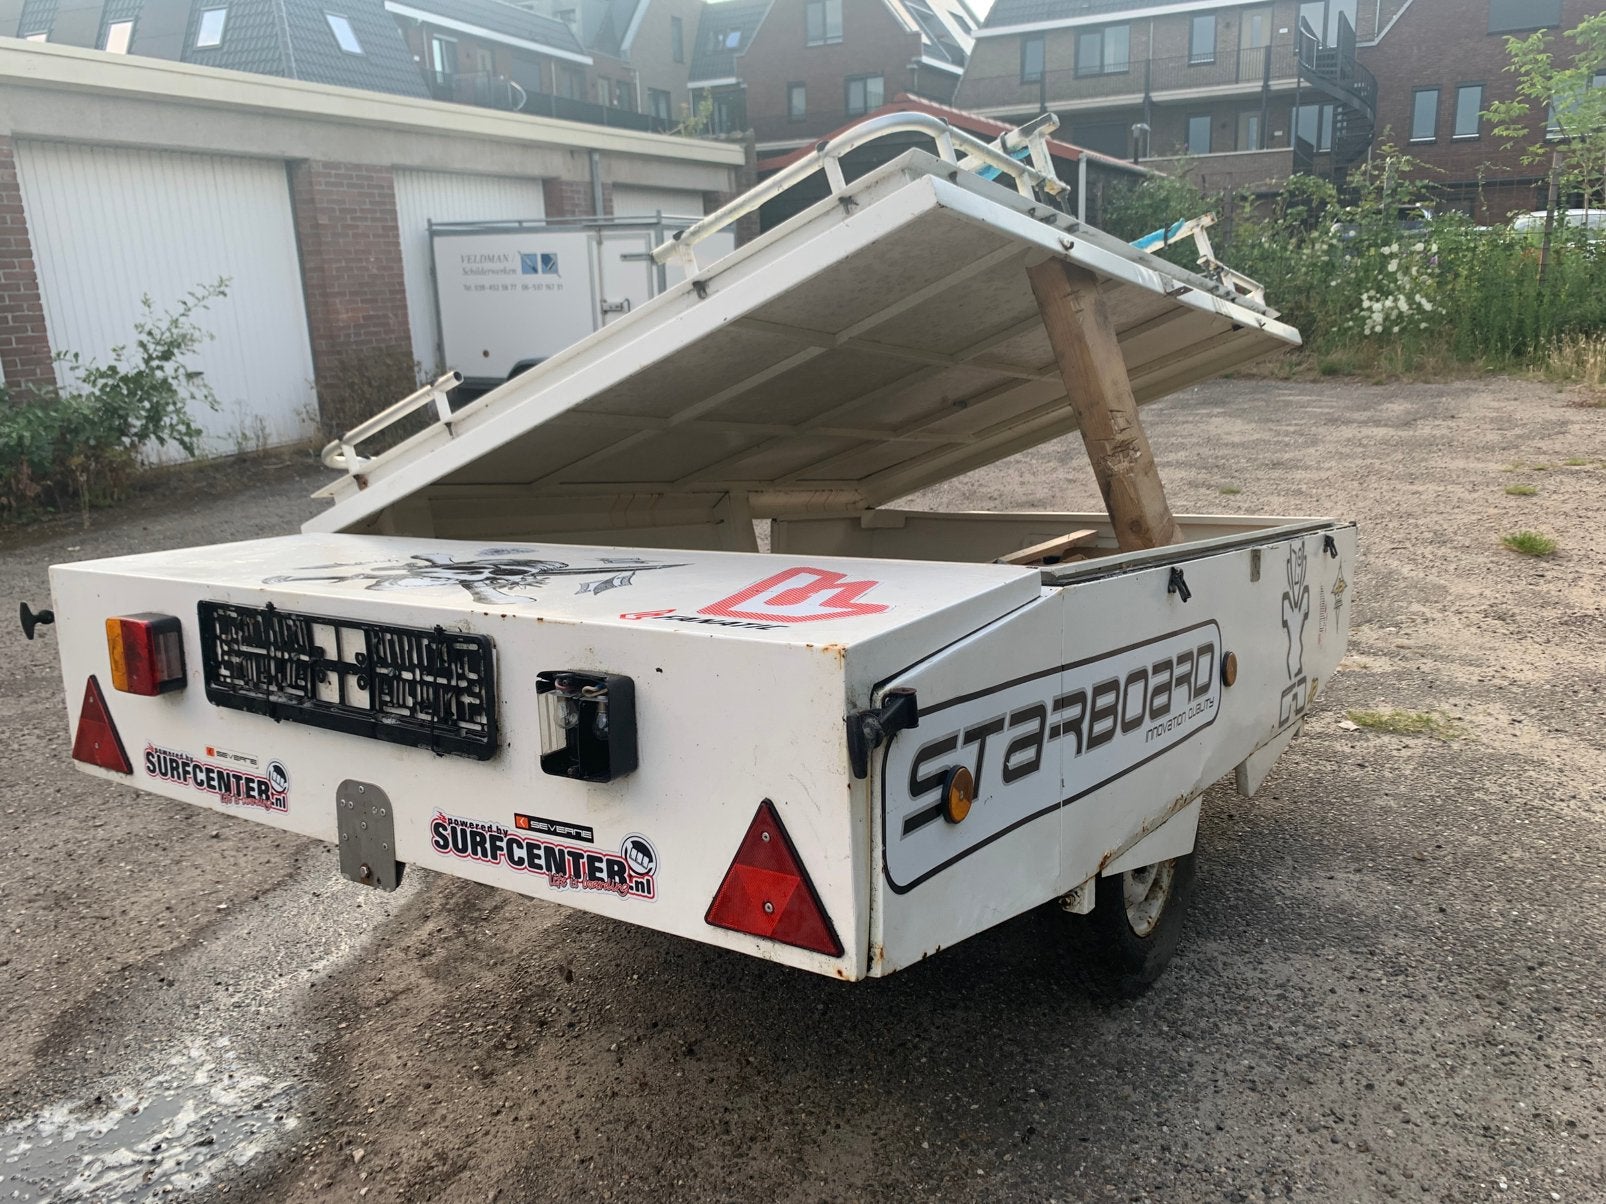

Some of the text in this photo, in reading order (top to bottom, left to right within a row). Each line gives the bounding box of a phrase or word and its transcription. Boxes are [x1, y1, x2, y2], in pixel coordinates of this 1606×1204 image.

[460, 253, 510, 264] VELDMAN
[447, 817, 509, 838] powered by
[531, 820, 592, 839] SEVERNE
